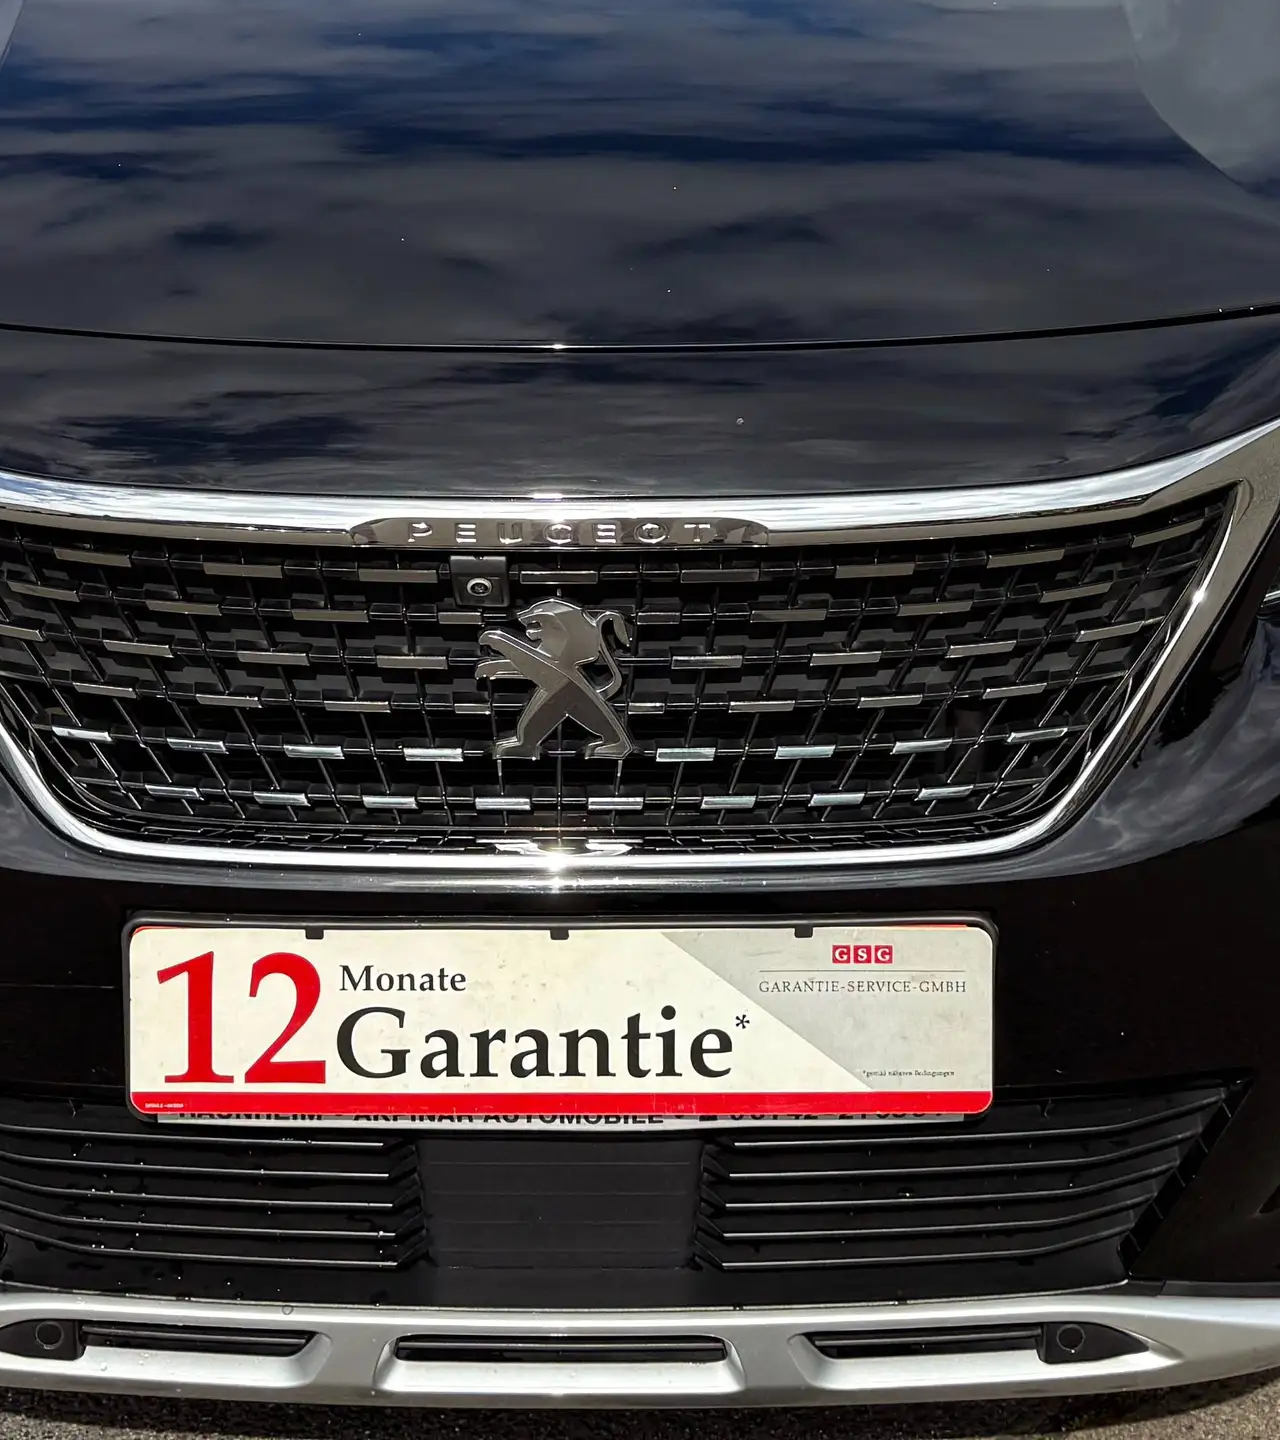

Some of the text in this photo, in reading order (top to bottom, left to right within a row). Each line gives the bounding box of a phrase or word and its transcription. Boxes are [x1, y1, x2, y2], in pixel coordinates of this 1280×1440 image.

[407, 522, 711, 544] PEUGEOT
[833, 946, 892, 963] GSG
[759, 980, 967, 993] GARANTIE-SERVICE-GMBH
[157, 951, 467, 1084] 12 Monate
